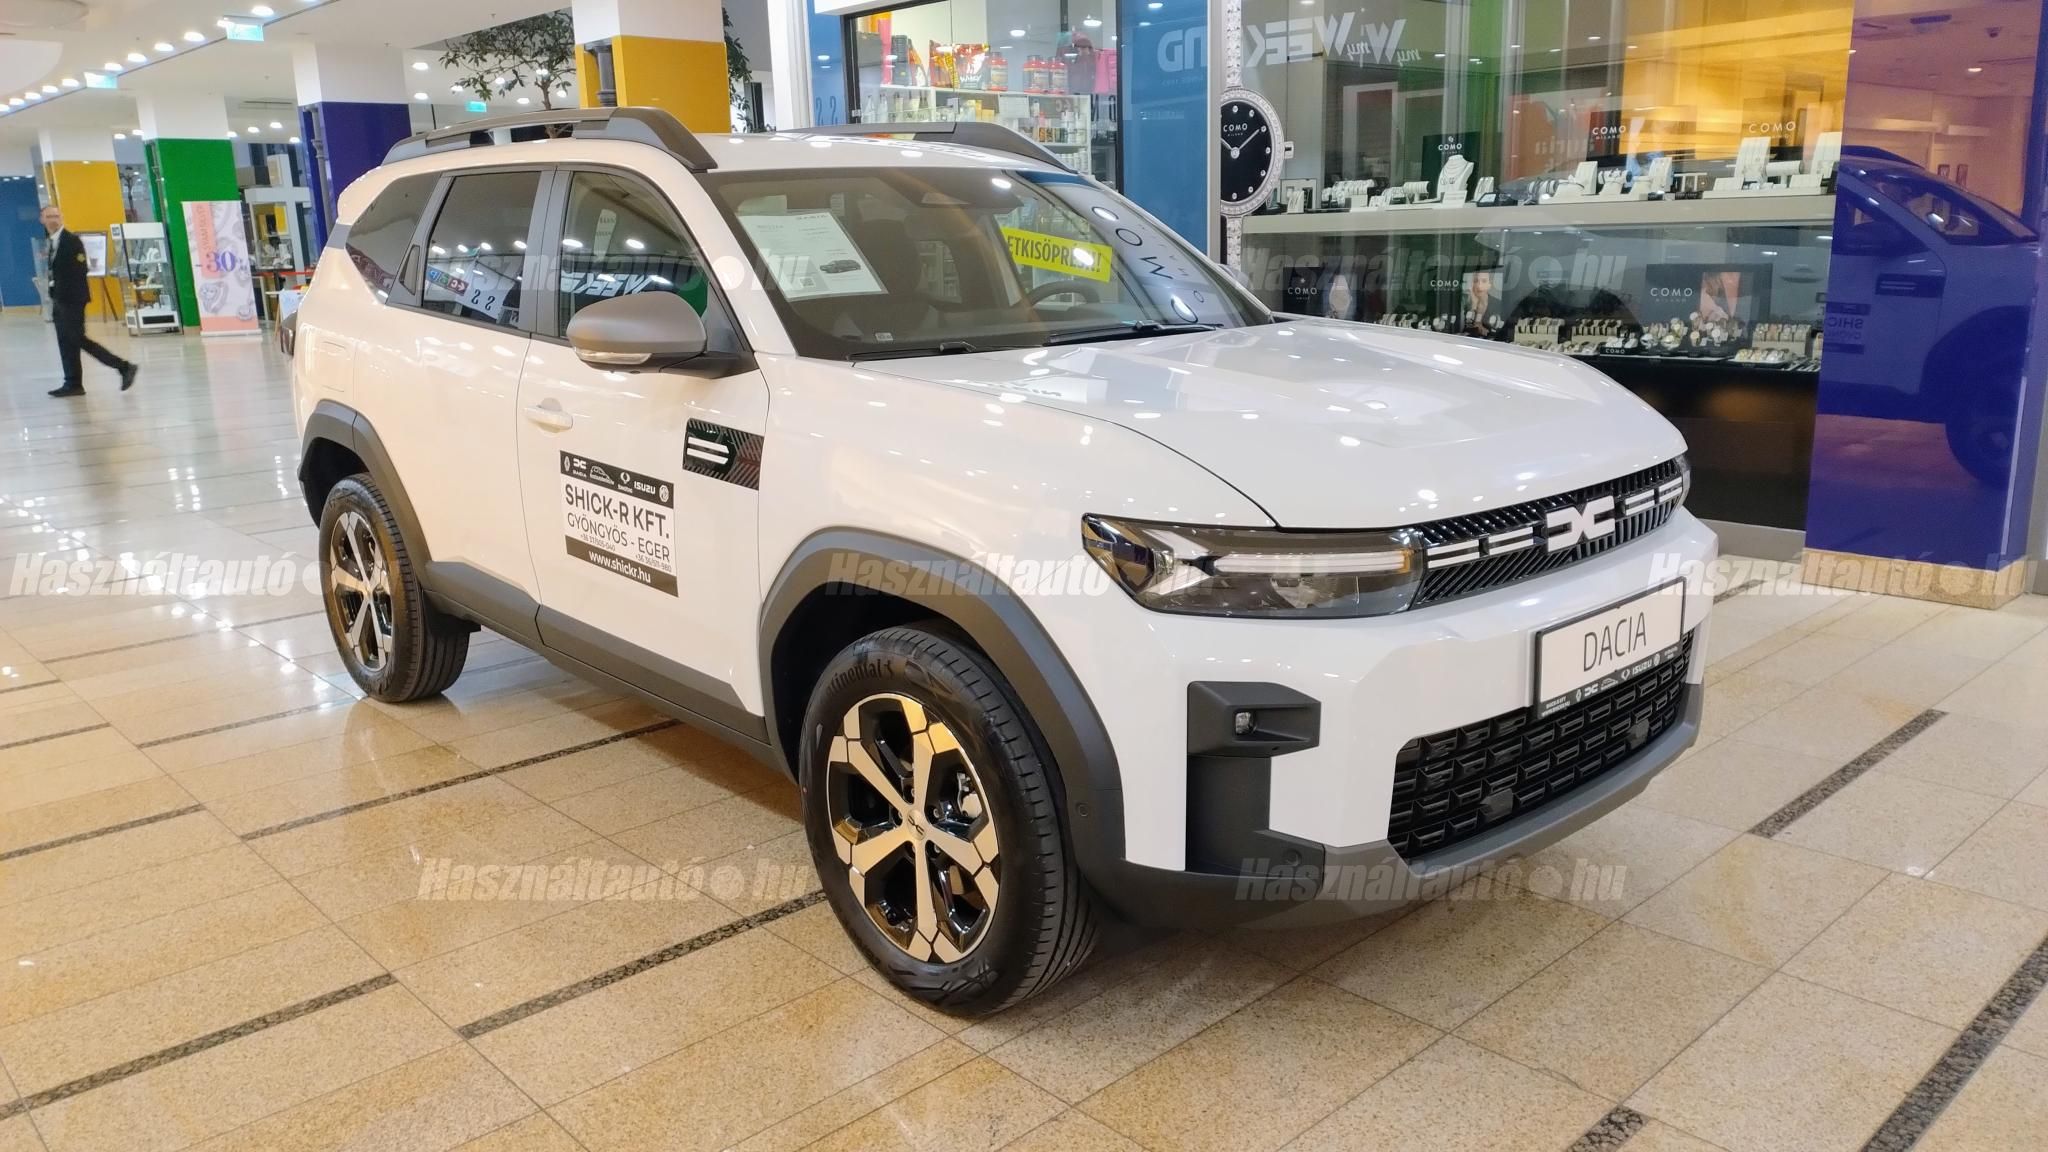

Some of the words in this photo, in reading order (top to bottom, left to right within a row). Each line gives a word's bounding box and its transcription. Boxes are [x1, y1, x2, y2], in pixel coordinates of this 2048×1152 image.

[1222, 122, 1248, 133] COMO
[1592, 125, 1627, 135] COMO
[1748, 121, 1796, 134] COMO
[1437, 143, 1463, 151] COMO
[1430, 279, 1459, 288] COMO
[1287, 286, 1318, 295] COMO
[1650, 287, 1693, 297] COMO
[634, 481, 656, 495] ISUZU
[565, 483, 629, 526] SHICK-R
[633, 505, 670, 539] KFT.
[567, 512, 628, 547] GYÖNGYÖS
[638, 537, 670, 562] EGER
[589, 551, 651, 583] www.shickr.hu
[1583, 612, 1647, 672] DACIA
[1632, 659, 1653, 675] ISUZU
